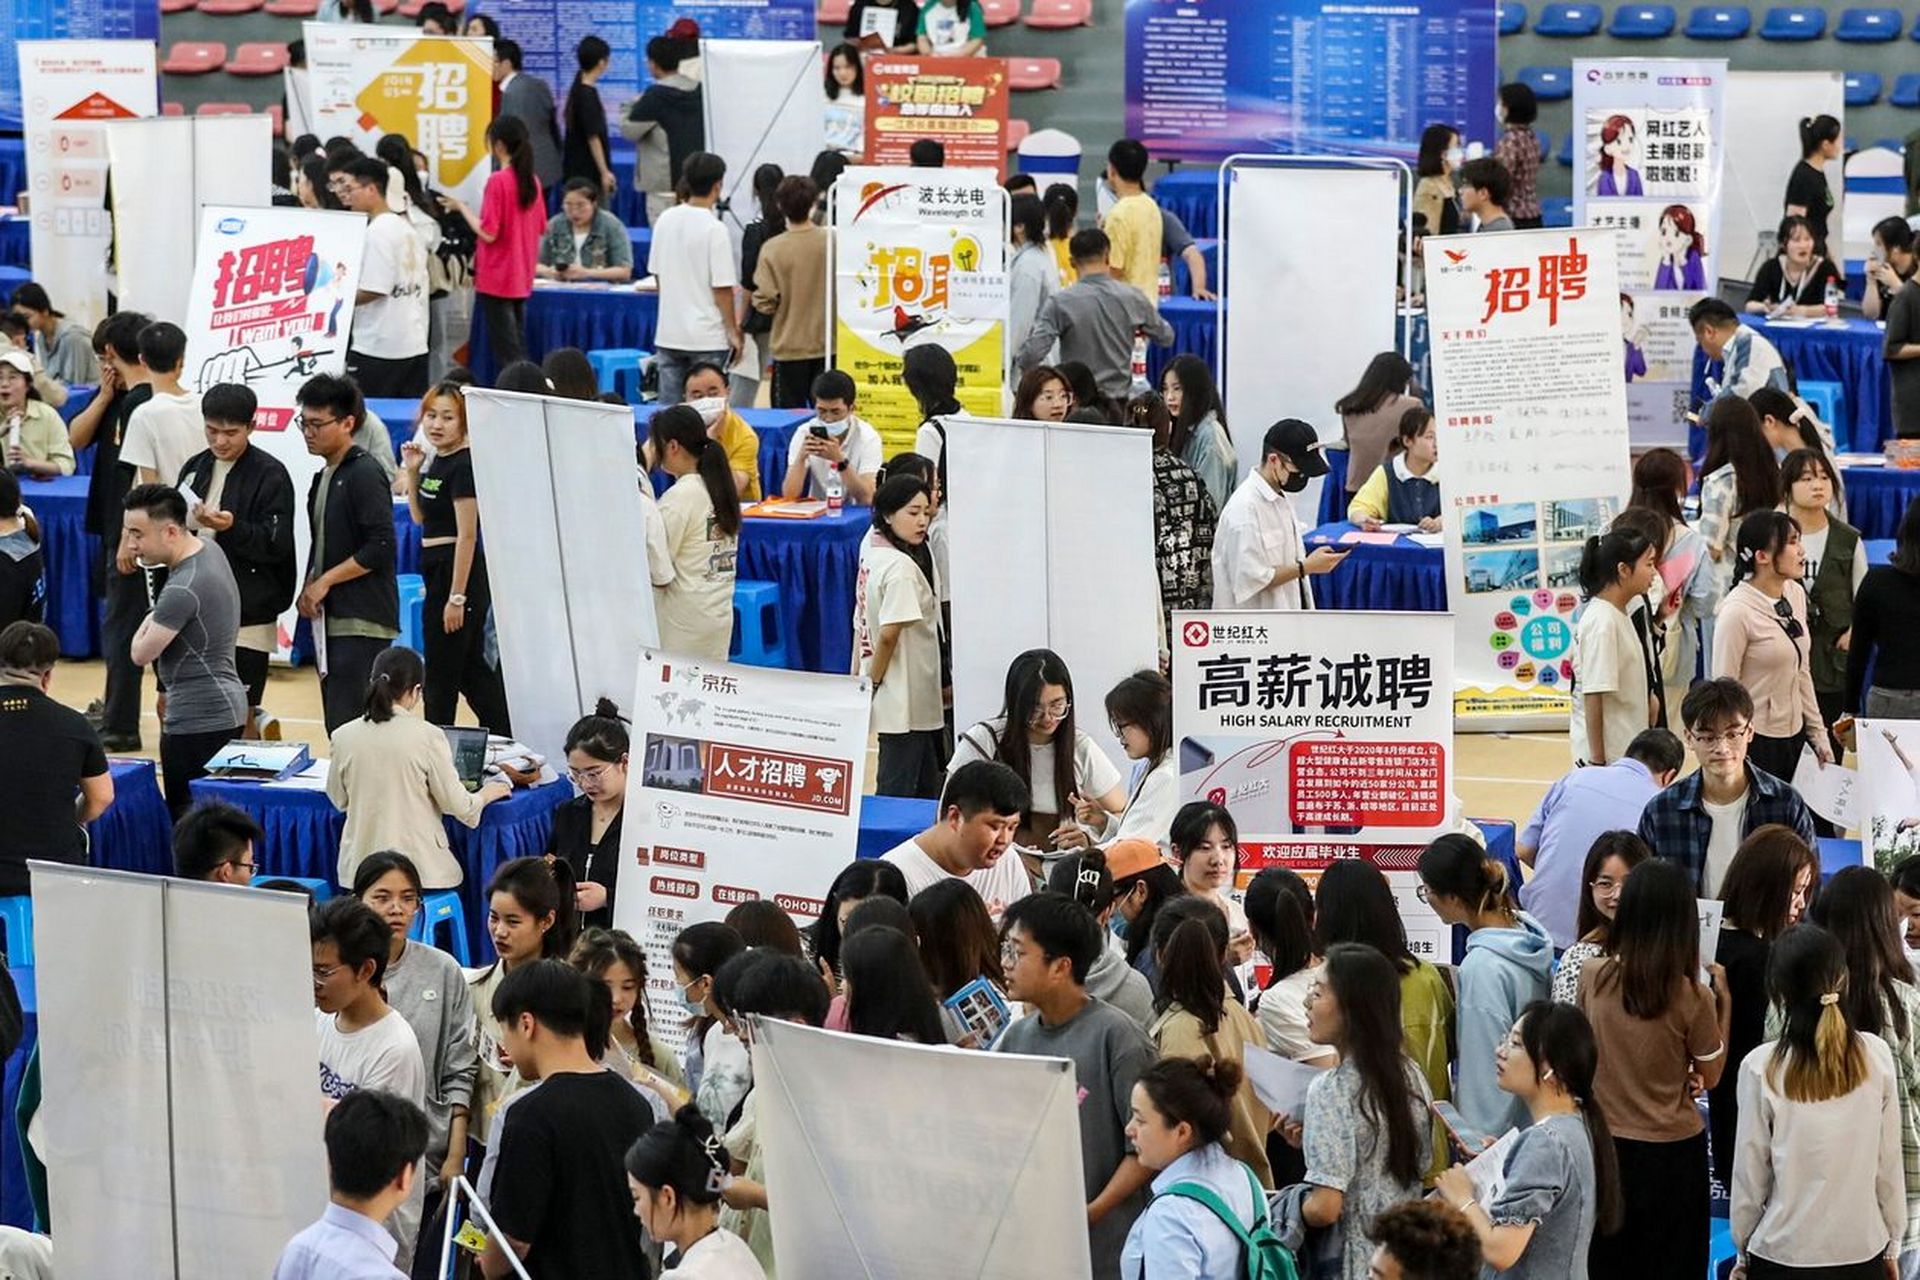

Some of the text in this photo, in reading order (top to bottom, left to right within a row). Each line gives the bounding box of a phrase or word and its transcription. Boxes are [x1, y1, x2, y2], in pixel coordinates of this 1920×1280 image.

[881, 84, 985, 105] 校园招聘
[416, 61, 469, 187] 招聘
[1646, 120, 1706, 138] 网红艺人
[1646, 143, 1705, 160] 主播招募
[919, 186, 986, 206] 波长光电
[919, 208, 984, 219] Wavelength OE
[1592, 216, 1640, 230] 才艺主播
[213, 235, 314, 308] 招聘
[1481, 237, 1588, 328] 招聘
[241, 319, 281, 344] want
[1441, 328, 1487, 341] 关于我们
[1448, 415, 1493, 427] 招聘岗位
[1212, 625, 1268, 639] 世纪红大
[1530, 622, 1561, 636] 公司
[1530, 637, 1562, 652] 福利
[702, 674, 739, 695] 京东
[1198, 653, 1433, 710] 高薪诚聘
[1220, 714, 1413, 728] HIGH SALARY RECRUITMENT
[714, 752, 808, 788] 人才招聘
[812, 794, 842, 805] JD.COM
[659, 849, 699, 864] 岗位类型
[1262, 845, 1361, 860] 欢迎应届毕业生
[655, 879, 696, 896] 热线顾问
[717, 888, 756, 903] 在线顾问
[648, 906, 684, 920] 任职要求
